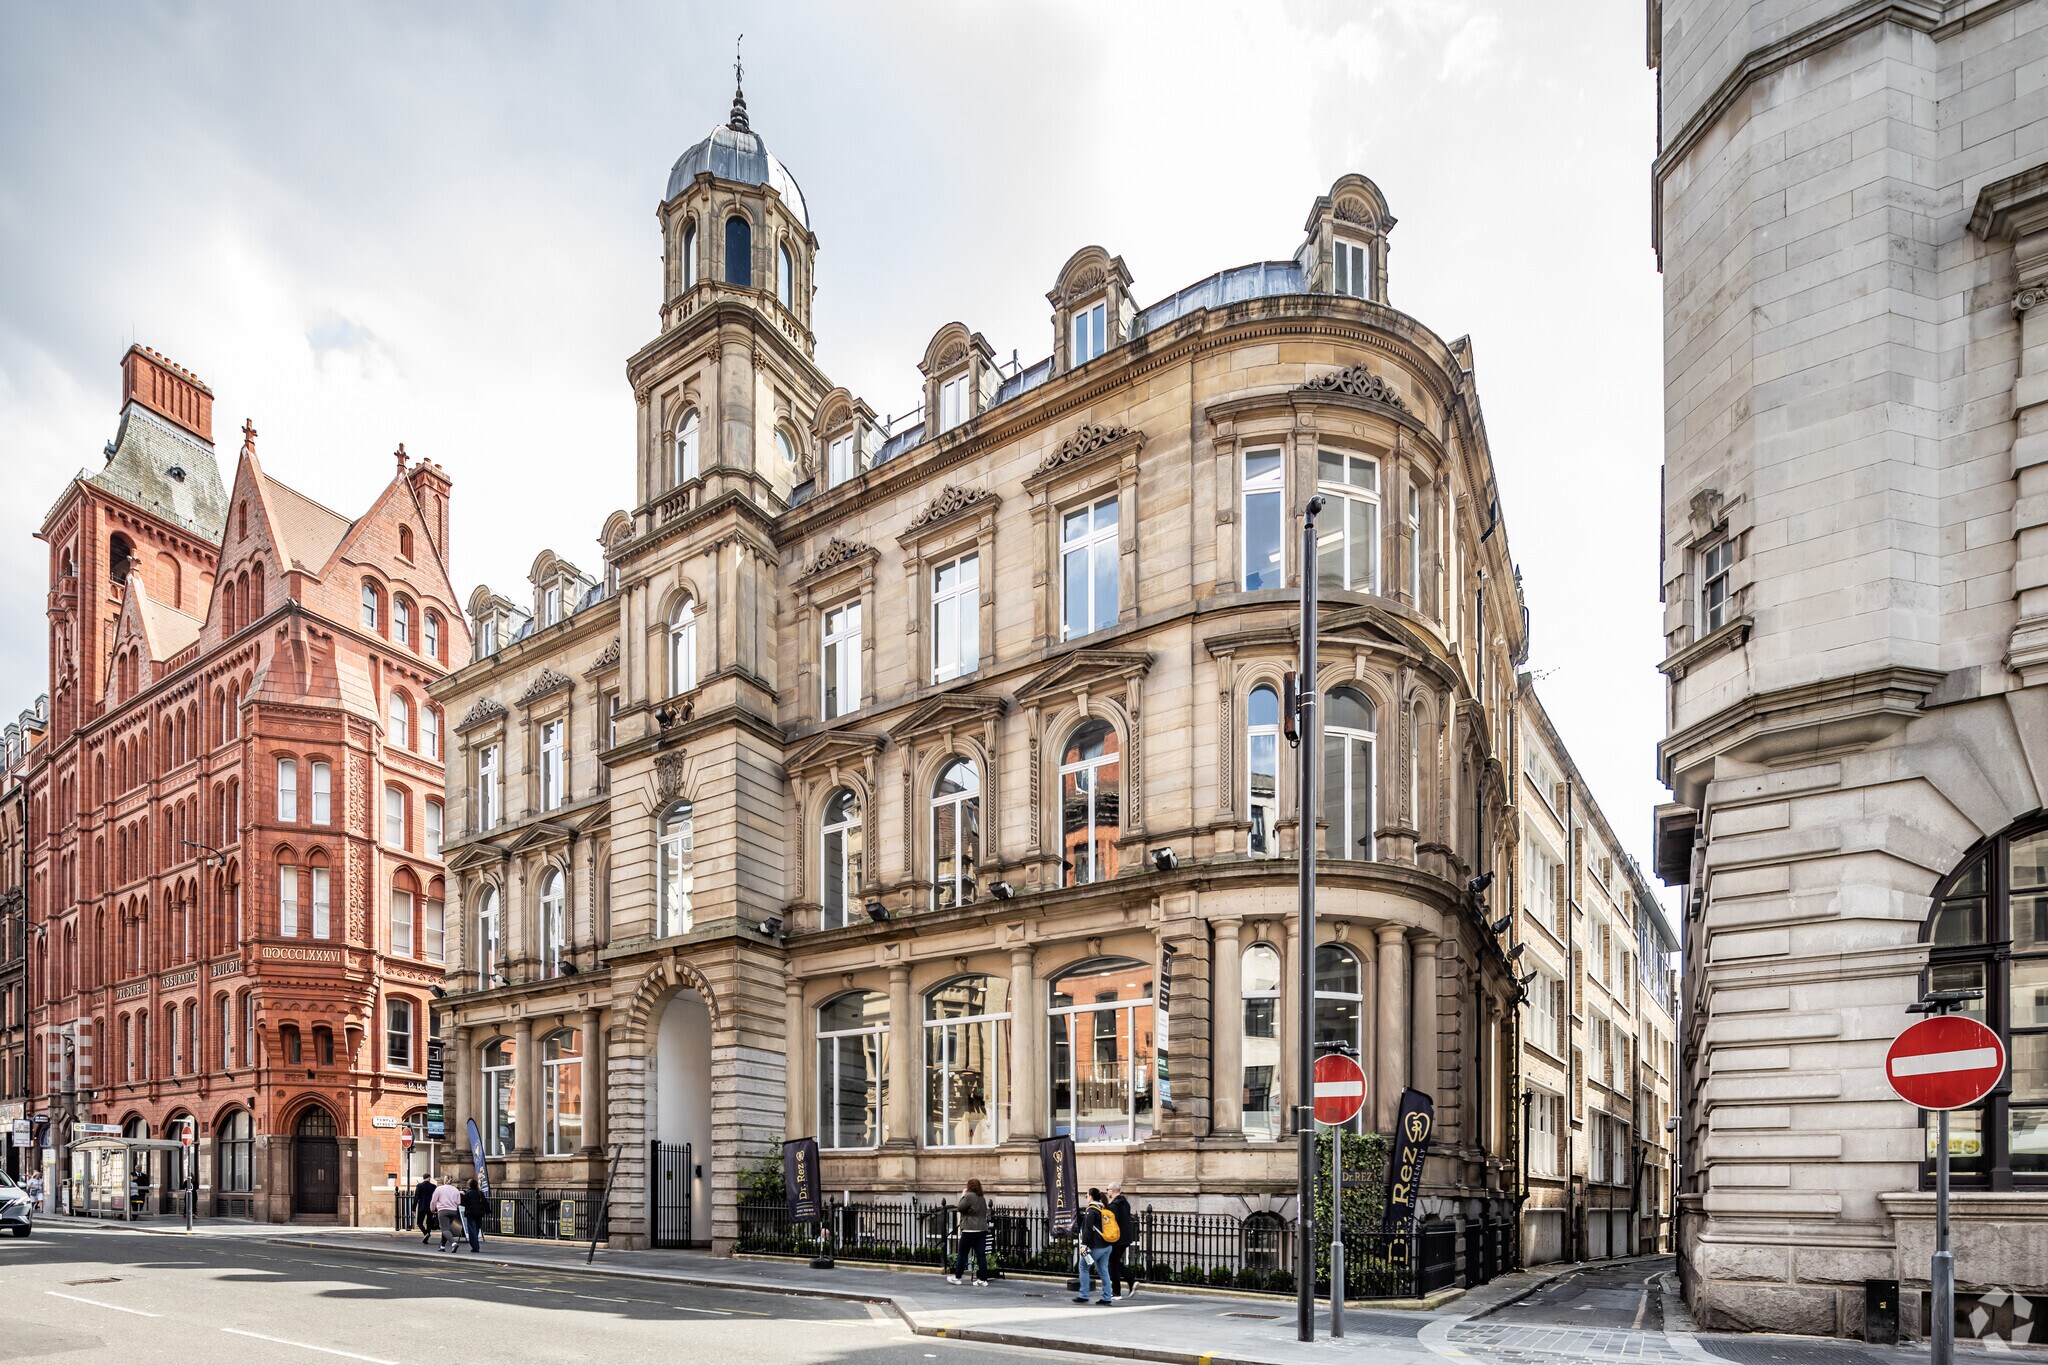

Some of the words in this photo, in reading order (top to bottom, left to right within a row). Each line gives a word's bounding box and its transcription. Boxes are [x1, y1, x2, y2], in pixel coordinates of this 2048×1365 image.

[262, 946, 341, 962] MDCCCLXXXVI
[797, 1163, 806, 1183] Rez
[1392, 1146, 1418, 1207] Rez
[1408, 1148, 1426, 1209] DIFFERENTLY
[799, 1183, 808, 1201] Dr.
[1056, 1190, 1064, 1209] Dr.
